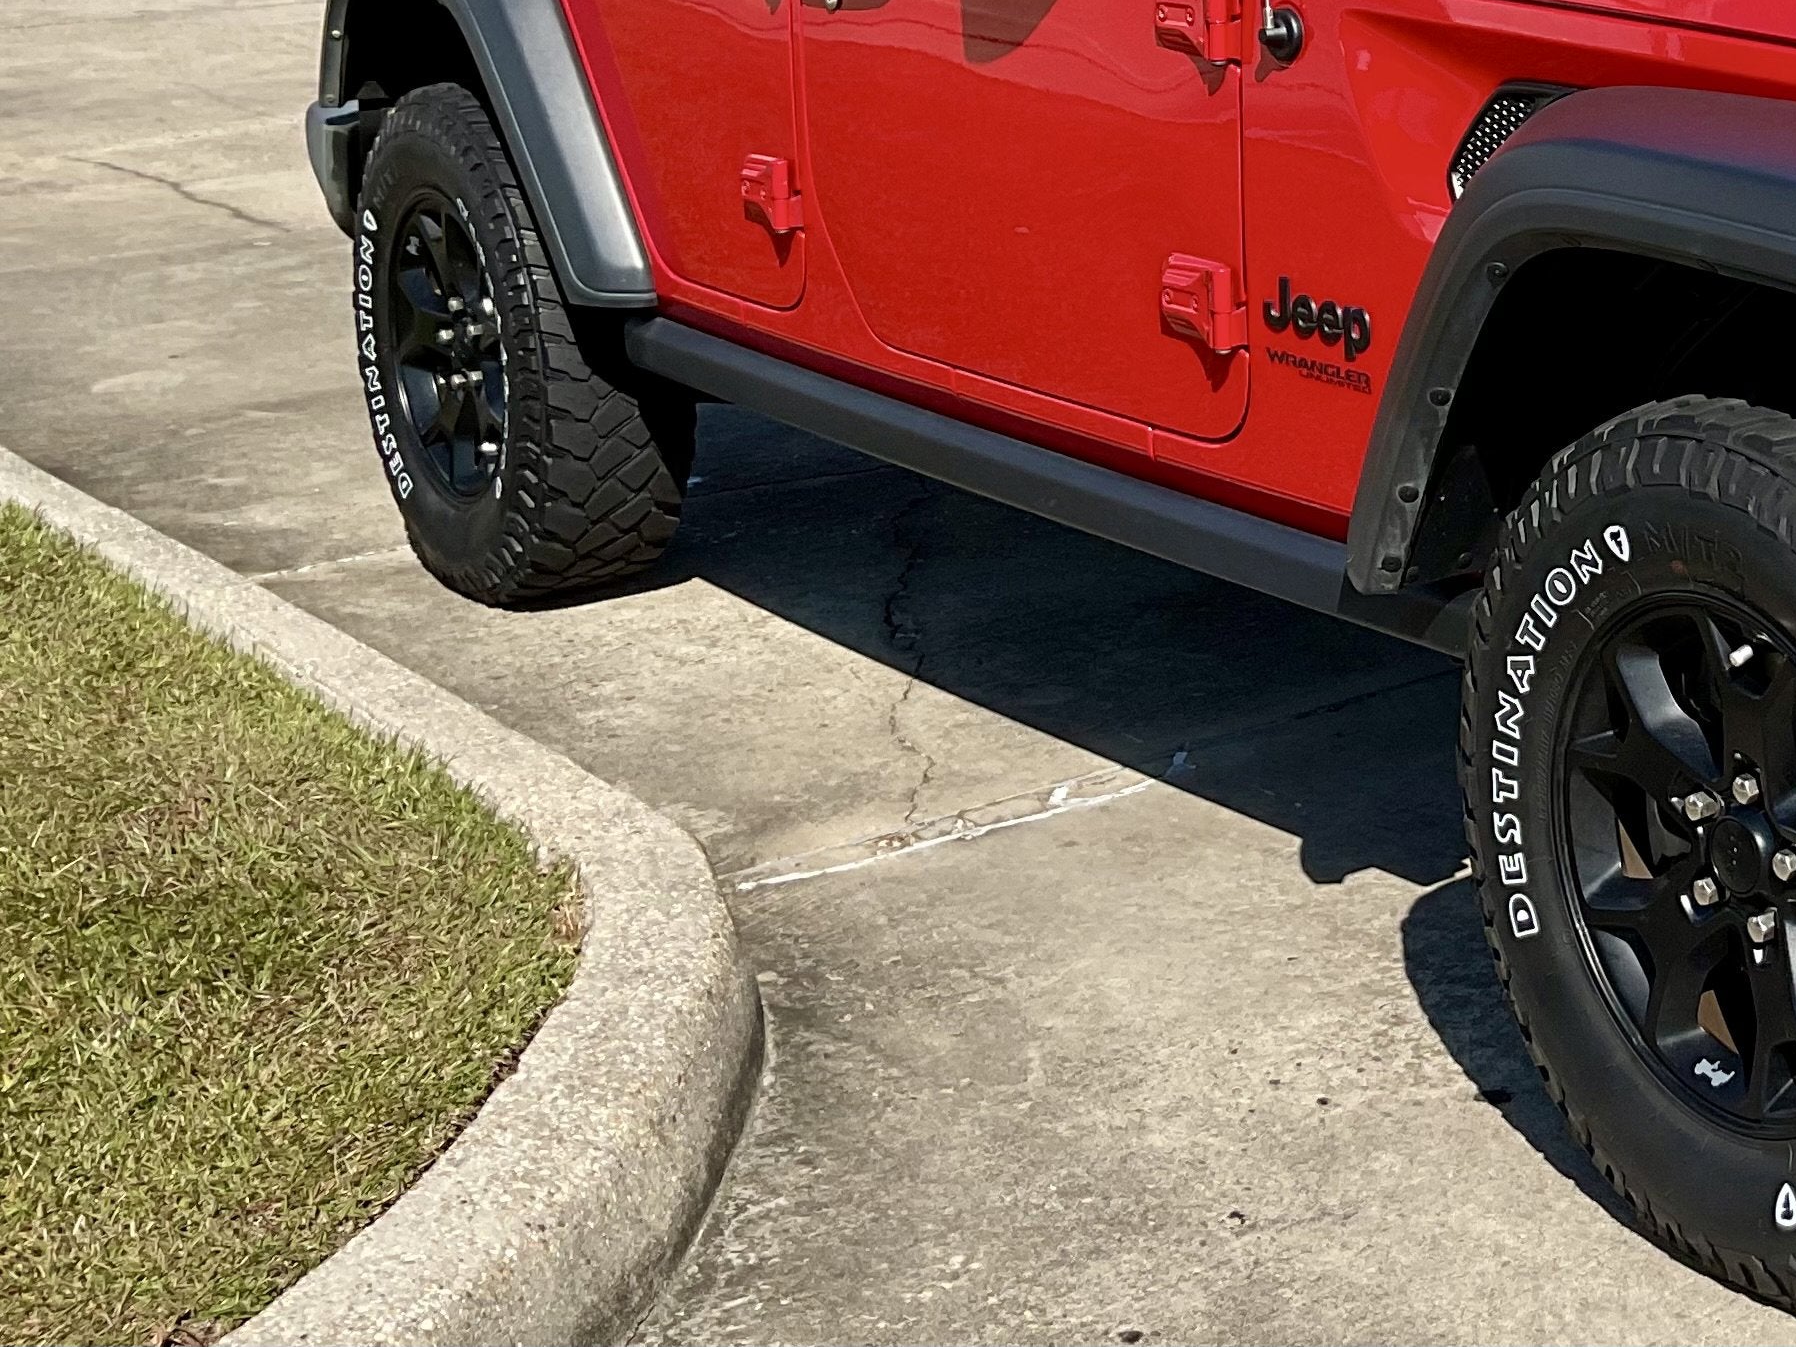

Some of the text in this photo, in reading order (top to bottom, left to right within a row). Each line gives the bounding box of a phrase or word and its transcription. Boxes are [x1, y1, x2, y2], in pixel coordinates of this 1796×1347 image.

[1263, 276, 1371, 362] Jeep
[356, 238, 413, 499] DESTINATION
[1266, 347, 1371, 387] WRANGLER
[1299, 369, 1372, 395] UNLIMITED
[1491, 537, 1605, 938] DESTINATION
